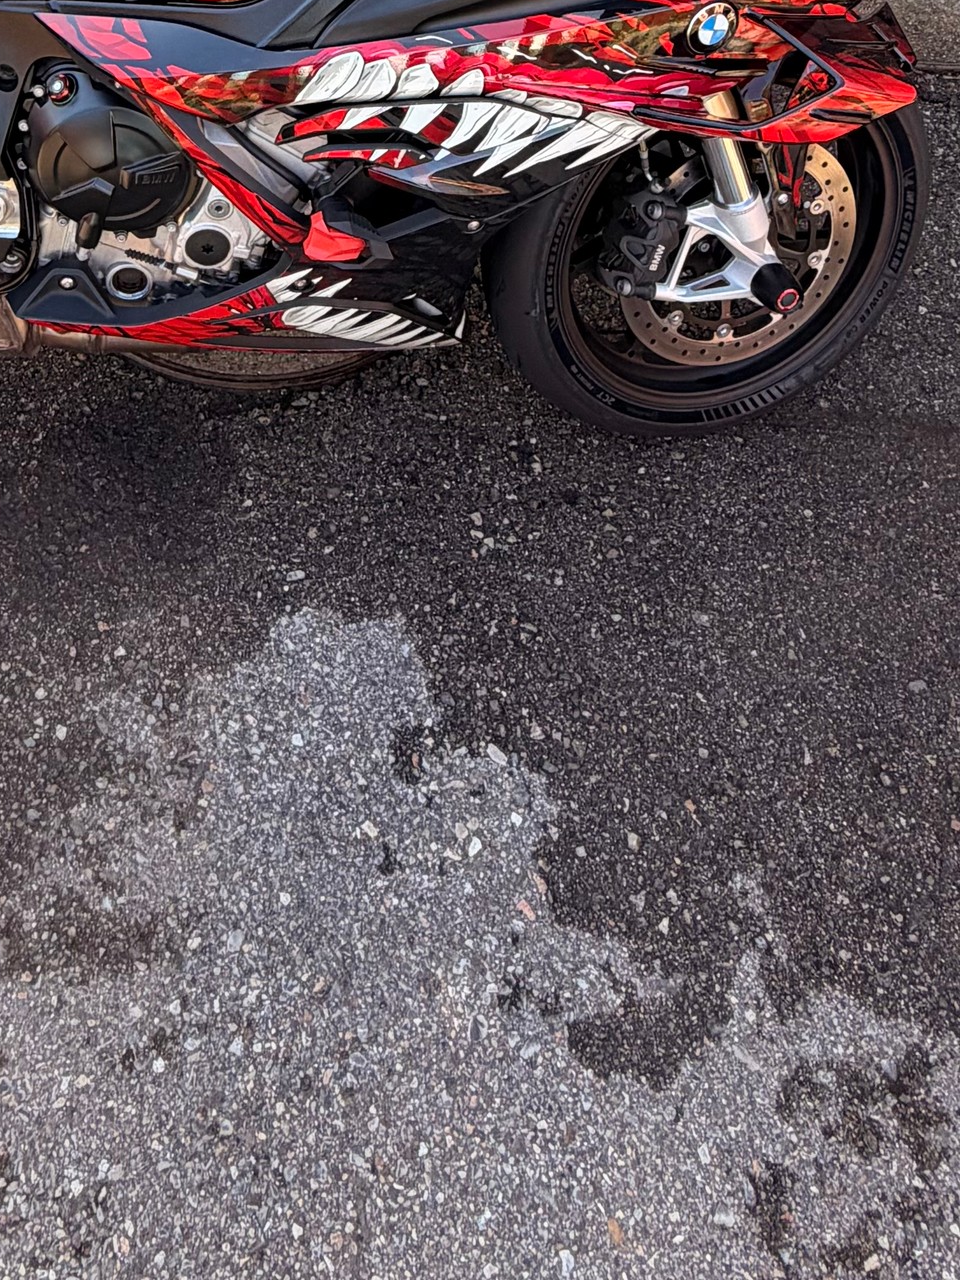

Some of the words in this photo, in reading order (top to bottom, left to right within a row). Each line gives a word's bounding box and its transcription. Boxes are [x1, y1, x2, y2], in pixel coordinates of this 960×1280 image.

[698, 4, 736, 22] BMW
[142, 172, 176, 185] BMW
[891, 190, 916, 272] MICHELIN
[545, 223, 565, 309] MICHELIN
[648, 244, 666, 272] BMW
[860, 280, 889, 324] POWER
